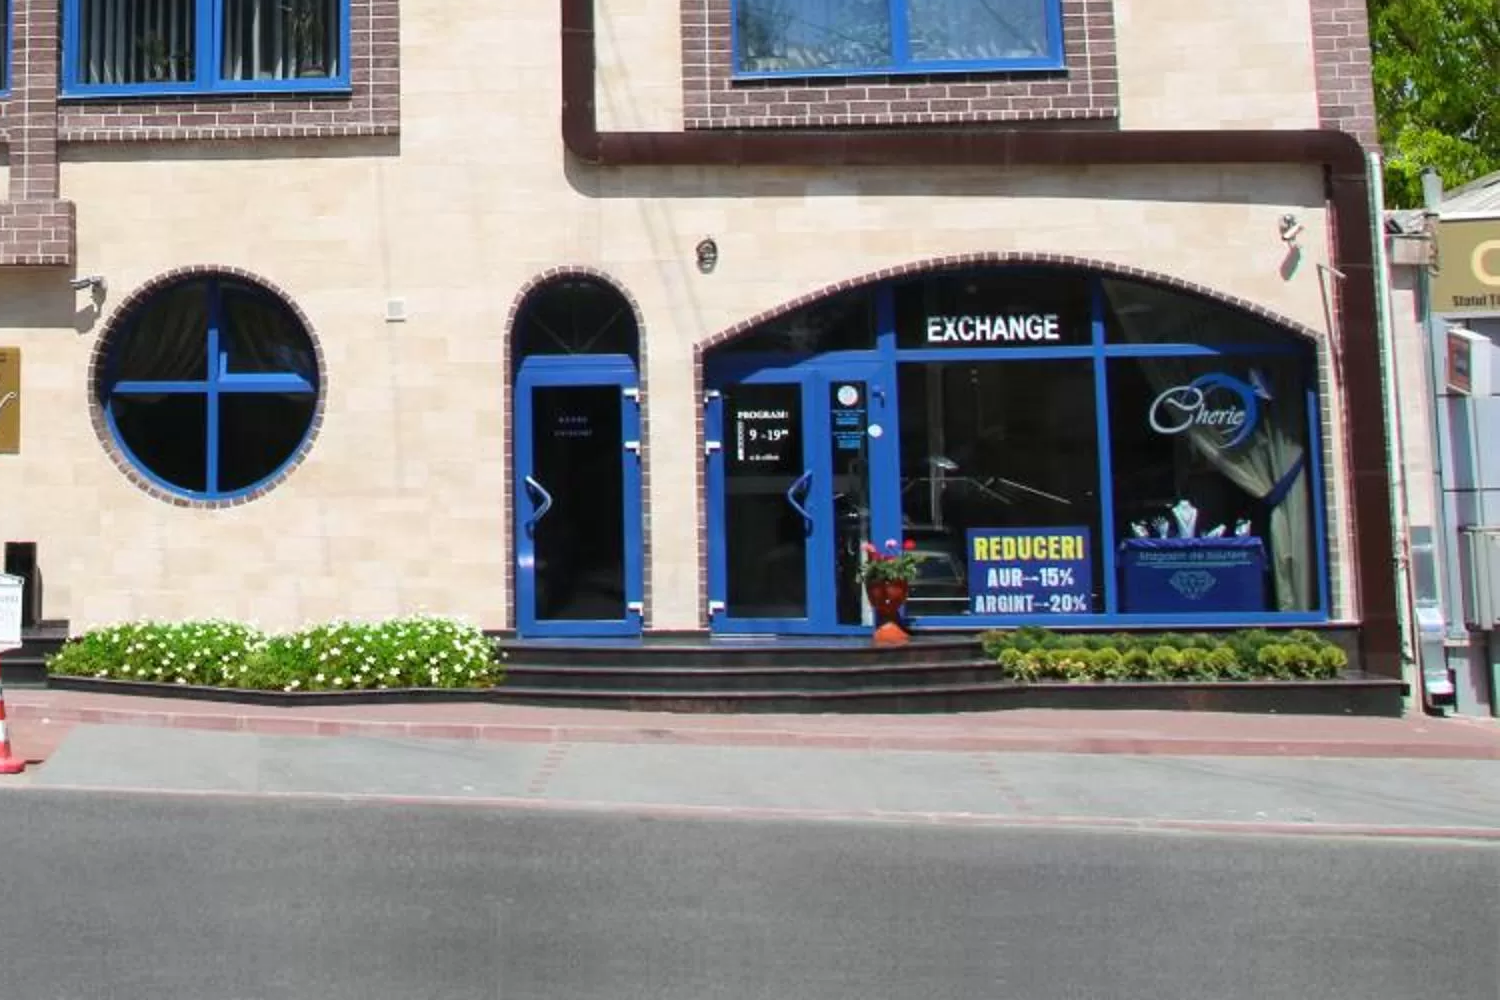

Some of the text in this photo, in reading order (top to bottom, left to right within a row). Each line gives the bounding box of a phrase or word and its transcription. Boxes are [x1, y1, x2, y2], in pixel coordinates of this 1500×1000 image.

[927, 313, 1061, 342] EXCHANGE
[1149, 385, 1246, 434] Cherie
[973, 535, 1084, 561] REDUCERI
